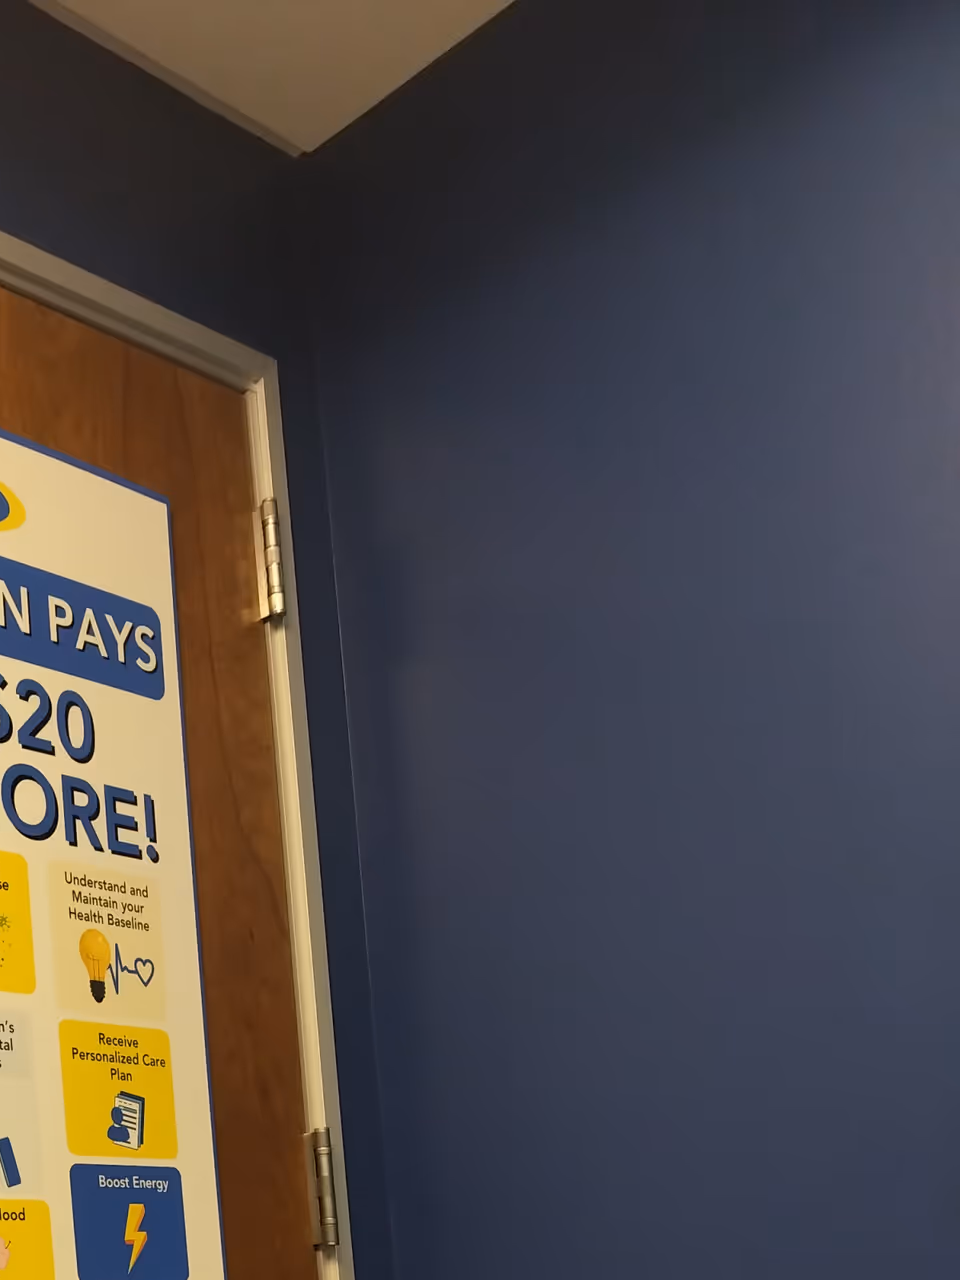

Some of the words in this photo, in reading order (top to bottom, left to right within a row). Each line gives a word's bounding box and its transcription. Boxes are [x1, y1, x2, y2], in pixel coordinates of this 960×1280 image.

[47, 595, 157, 673] PAYS
[64, 871, 126, 894] Understand
[129, 885, 148, 898] and
[71, 889, 118, 909] Maintain
[120, 901, 144, 914] your
[68, 906, 103, 924] Health
[107, 913, 149, 931] Baseline
[98, 1032, 139, 1048] Receive
[71, 1047, 139, 1065] Personalized
[142, 1053, 165, 1068] Care
[110, 1067, 132, 1081] Plan
[98, 1174, 129, 1188] Boost
[132, 1175, 168, 1192] Energy
